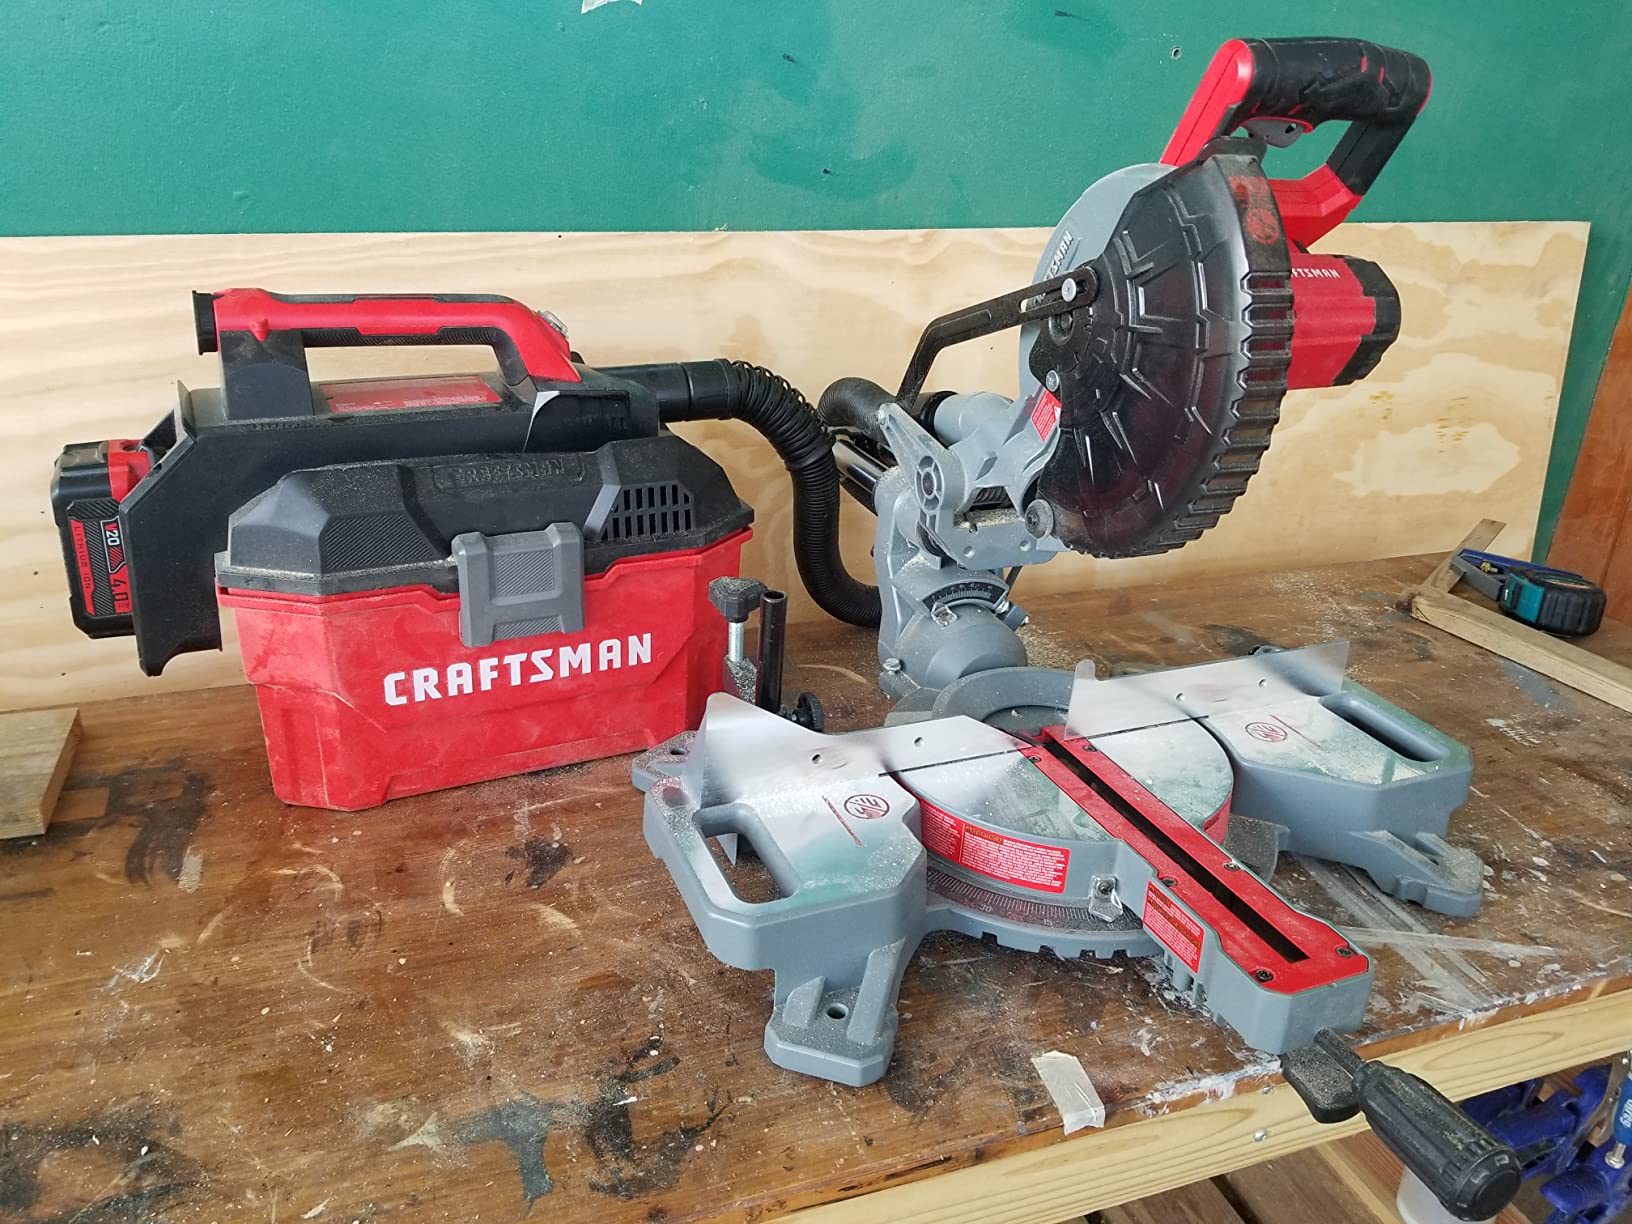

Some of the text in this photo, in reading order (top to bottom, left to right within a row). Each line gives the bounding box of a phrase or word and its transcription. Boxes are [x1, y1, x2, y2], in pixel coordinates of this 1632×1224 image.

[1291, 267, 1340, 278] FTSMAN
[103, 523, 120, 546] V20
[74, 526, 92, 589] LITHIUM ION
[112, 578, 129, 602] 4.0
[383, 633, 652, 706] CRAFTSMAN
[979, 904, 993, 913] 30
